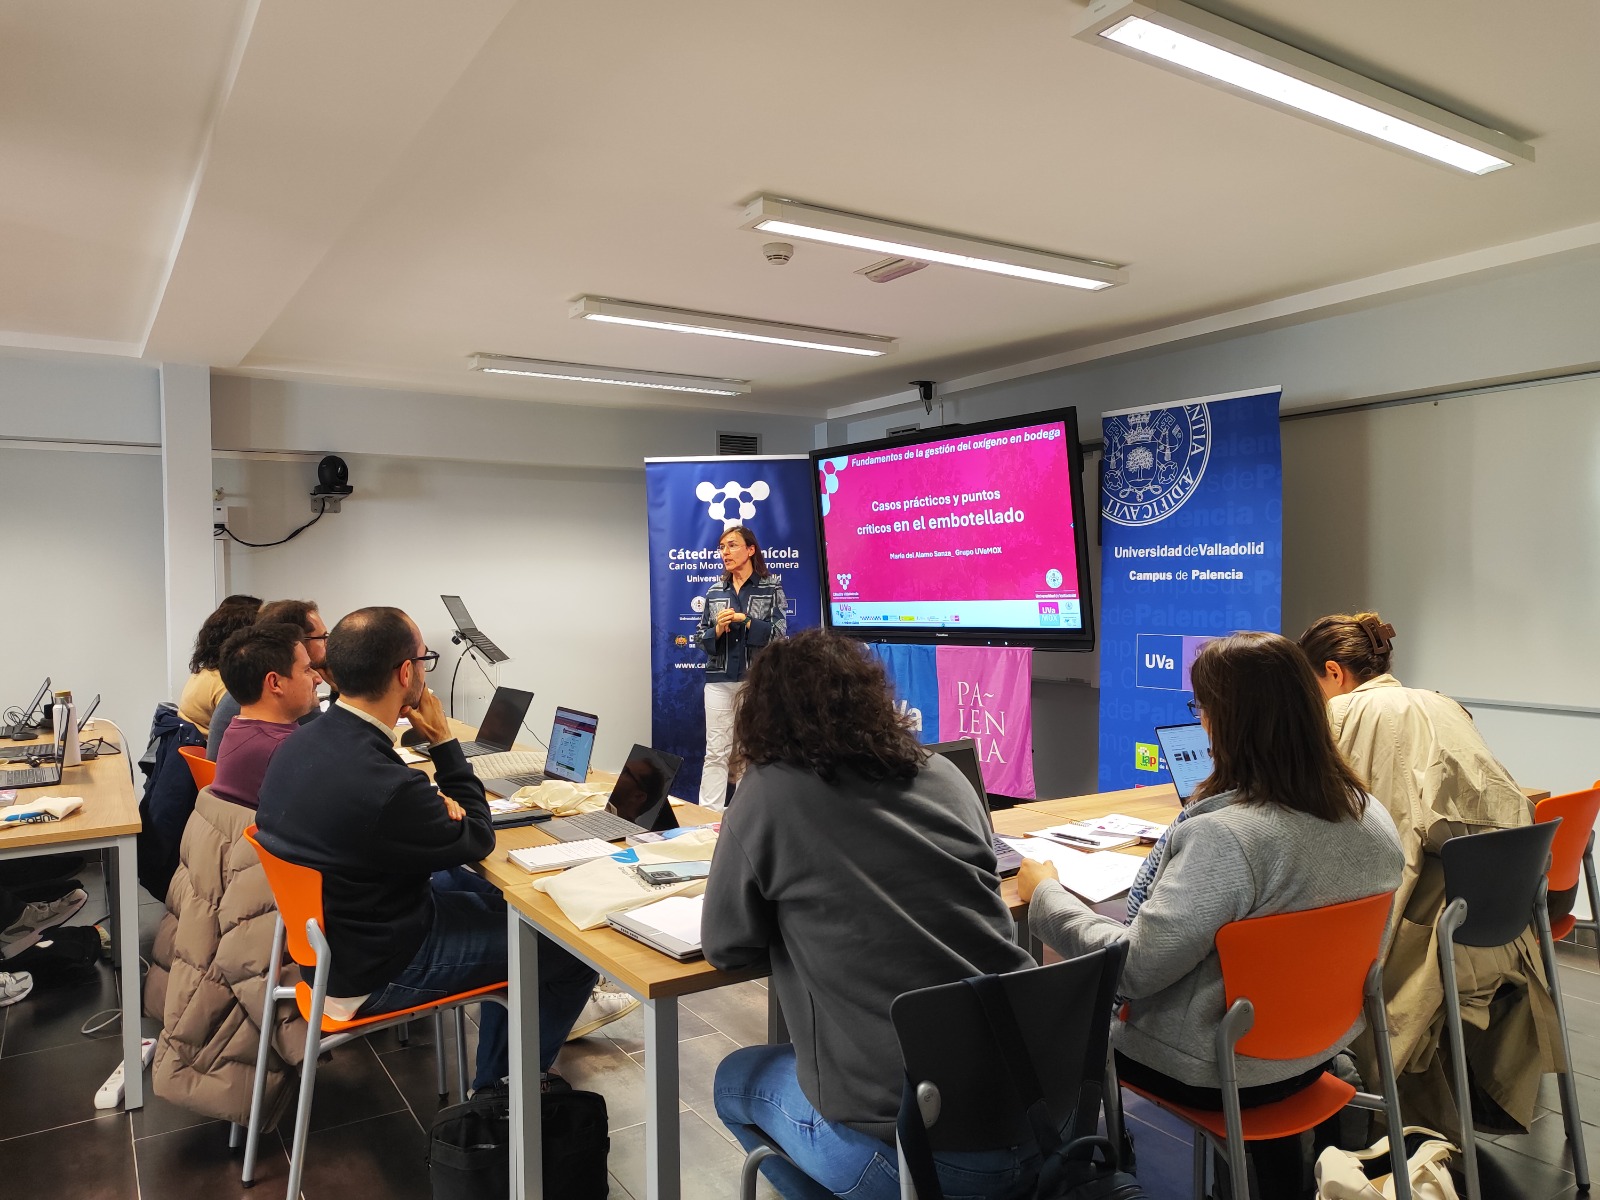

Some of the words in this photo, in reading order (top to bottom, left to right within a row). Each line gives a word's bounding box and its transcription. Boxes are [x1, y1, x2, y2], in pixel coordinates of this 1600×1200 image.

[851, 453, 903, 467] Fundamentos
[904, 450, 914, 459] de
[916, 449, 924, 457] la
[925, 444, 955, 458] gestión
[957, 441, 971, 451] del
[973, 436, 1008, 450] oxígeno
[1010, 435, 1022, 444] en
[1023, 428, 1061, 443] bodega
[872, 501, 902, 512] Casos
[904, 494, 951, 511] prácticos
[952, 495, 960, 506] y
[961, 489, 1001, 505] puntos
[857, 523, 892, 535] críticos
[894, 521, 910, 533] en
[913, 516, 926, 531] el
[928, 507, 1025, 529] embotellado
[669, 548, 721, 560] Cátedra
[955, 548, 974, 557] Grupo
[974, 546, 1002, 555] UVaMOX
[669, 562, 698, 570] Carlos
[699, 562, 724, 570] Moro
[686, 575, 723, 583] Universi
[1129, 570, 1173, 582] Campus
[1175, 570, 1188, 581] de
[1191, 568, 1244, 581] Palencia
[1041, 606, 1056, 614] UVa
[1145, 653, 1174, 670] UVa
[958, 708, 1006, 737] LEN
